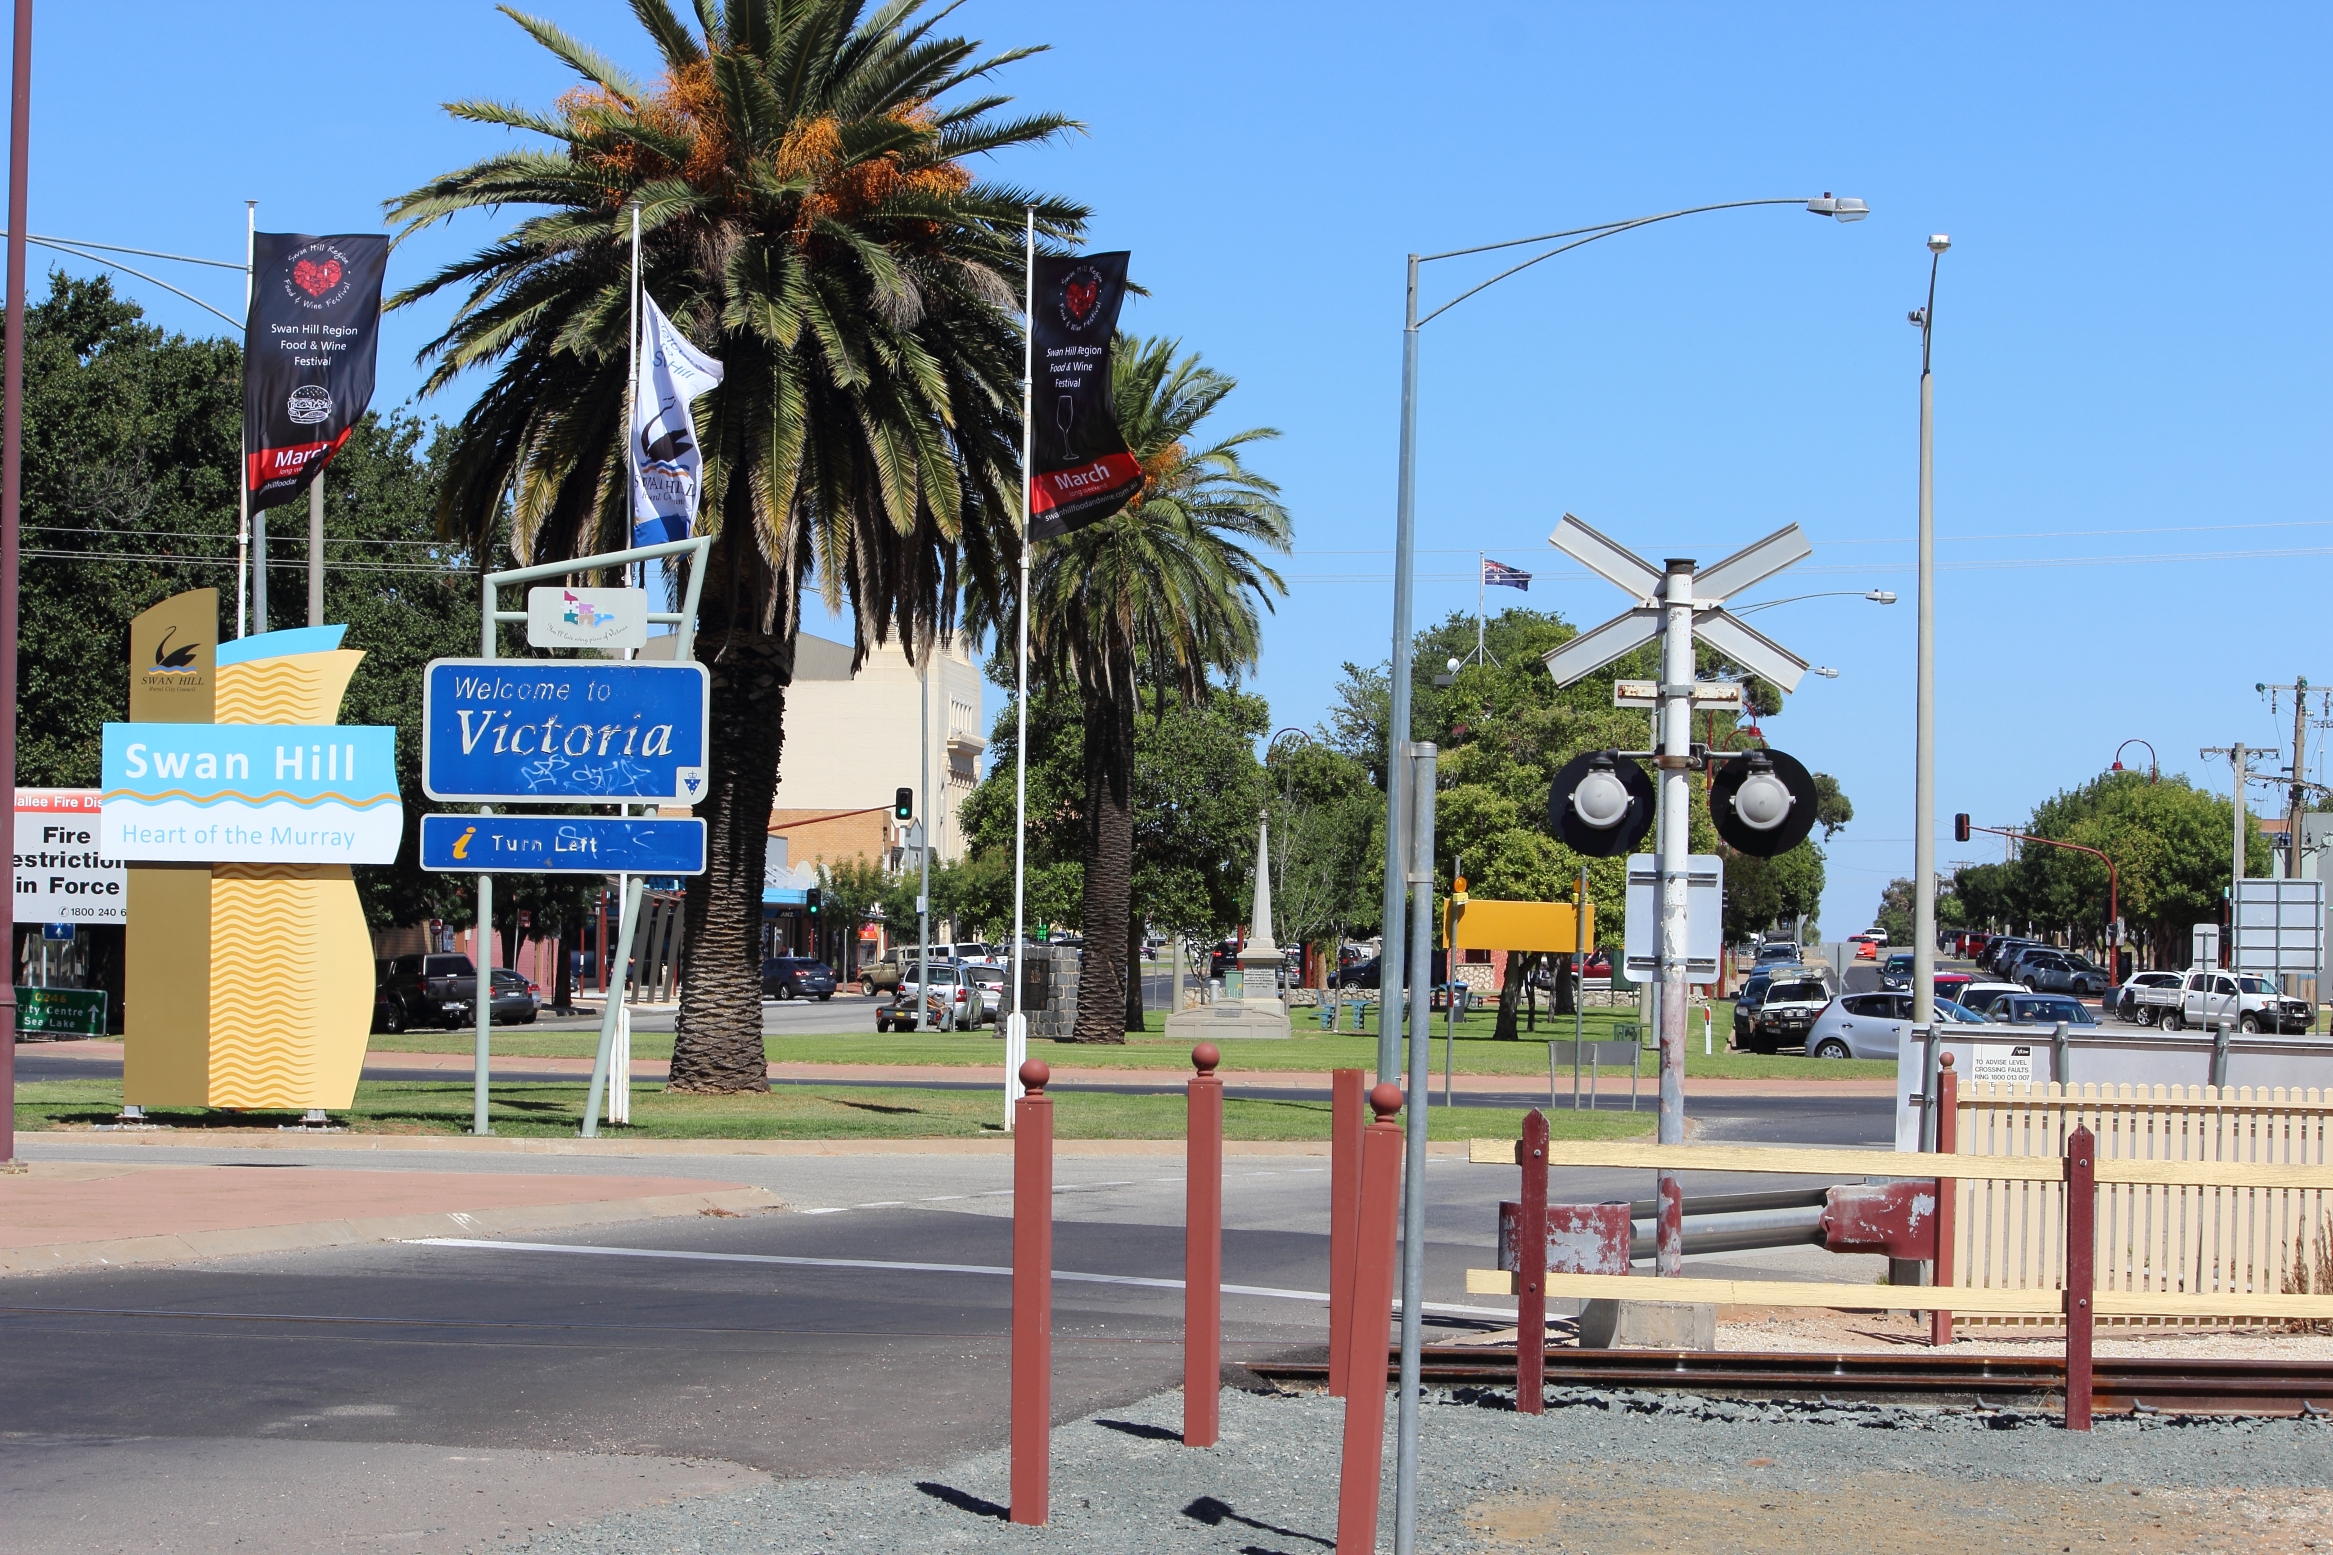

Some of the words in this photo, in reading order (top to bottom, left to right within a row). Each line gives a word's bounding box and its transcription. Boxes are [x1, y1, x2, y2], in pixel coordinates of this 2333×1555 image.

[288, 248, 308, 262] Swan
[310, 243, 325, 251] Hill
[327, 245, 349, 264] Region
[284, 278, 296, 297] Food
[303, 299, 323, 310] Wine
[325, 281, 351, 308] Festival
[271, 323, 299, 334] Swan
[302, 323, 320, 335] Hill
[323, 325, 358, 338] Region
[280, 340, 306, 350] Food
[310, 341, 318, 350] &
[320, 340, 347, 351] Wine
[1046, 347, 1064, 358] Swan
[1064, 345, 1077, 356] Hill
[1077, 344, 1102, 358] Region
[294, 356, 331, 366] Festival
[1050, 361, 1066, 373] Food
[1072, 361, 1093, 372] Wine
[1055, 377, 1081, 388] Festival
[1054, 463, 1111, 490] March
[1068, 489, 1083, 497] long
[1082, 482, 1108, 494] weekend
[141, 676, 174, 685] SWAN
[178, 676, 204, 686] HILL
[455, 677, 570, 701] Welcome
[588, 679, 611, 701] to
[456, 709, 673, 757] Victoria
[125, 743, 249, 779] Swan
[275, 744, 355, 781] Hill
[54, 797, 78, 808] Fire
[43, 826, 91, 844] Fire
[122, 824, 187, 845] Heart
[194, 823, 218, 845] of
[225, 824, 263, 847] the
[271, 826, 356, 850] Murray
[492, 835, 542, 852] Turn
[555, 836, 597, 853] Left
[16, 876, 37, 893] in
[49, 877, 120, 895] Force
[71, 908, 95, 916] 1800
[98, 908, 116, 916] 240
[34, 992, 67, 1003] C246
[17, 1004, 40, 1016] City
[46, 1005, 84, 1016] Centre
[24, 1016, 44, 1026] Sea
[49, 1018, 75, 1028] Lake
